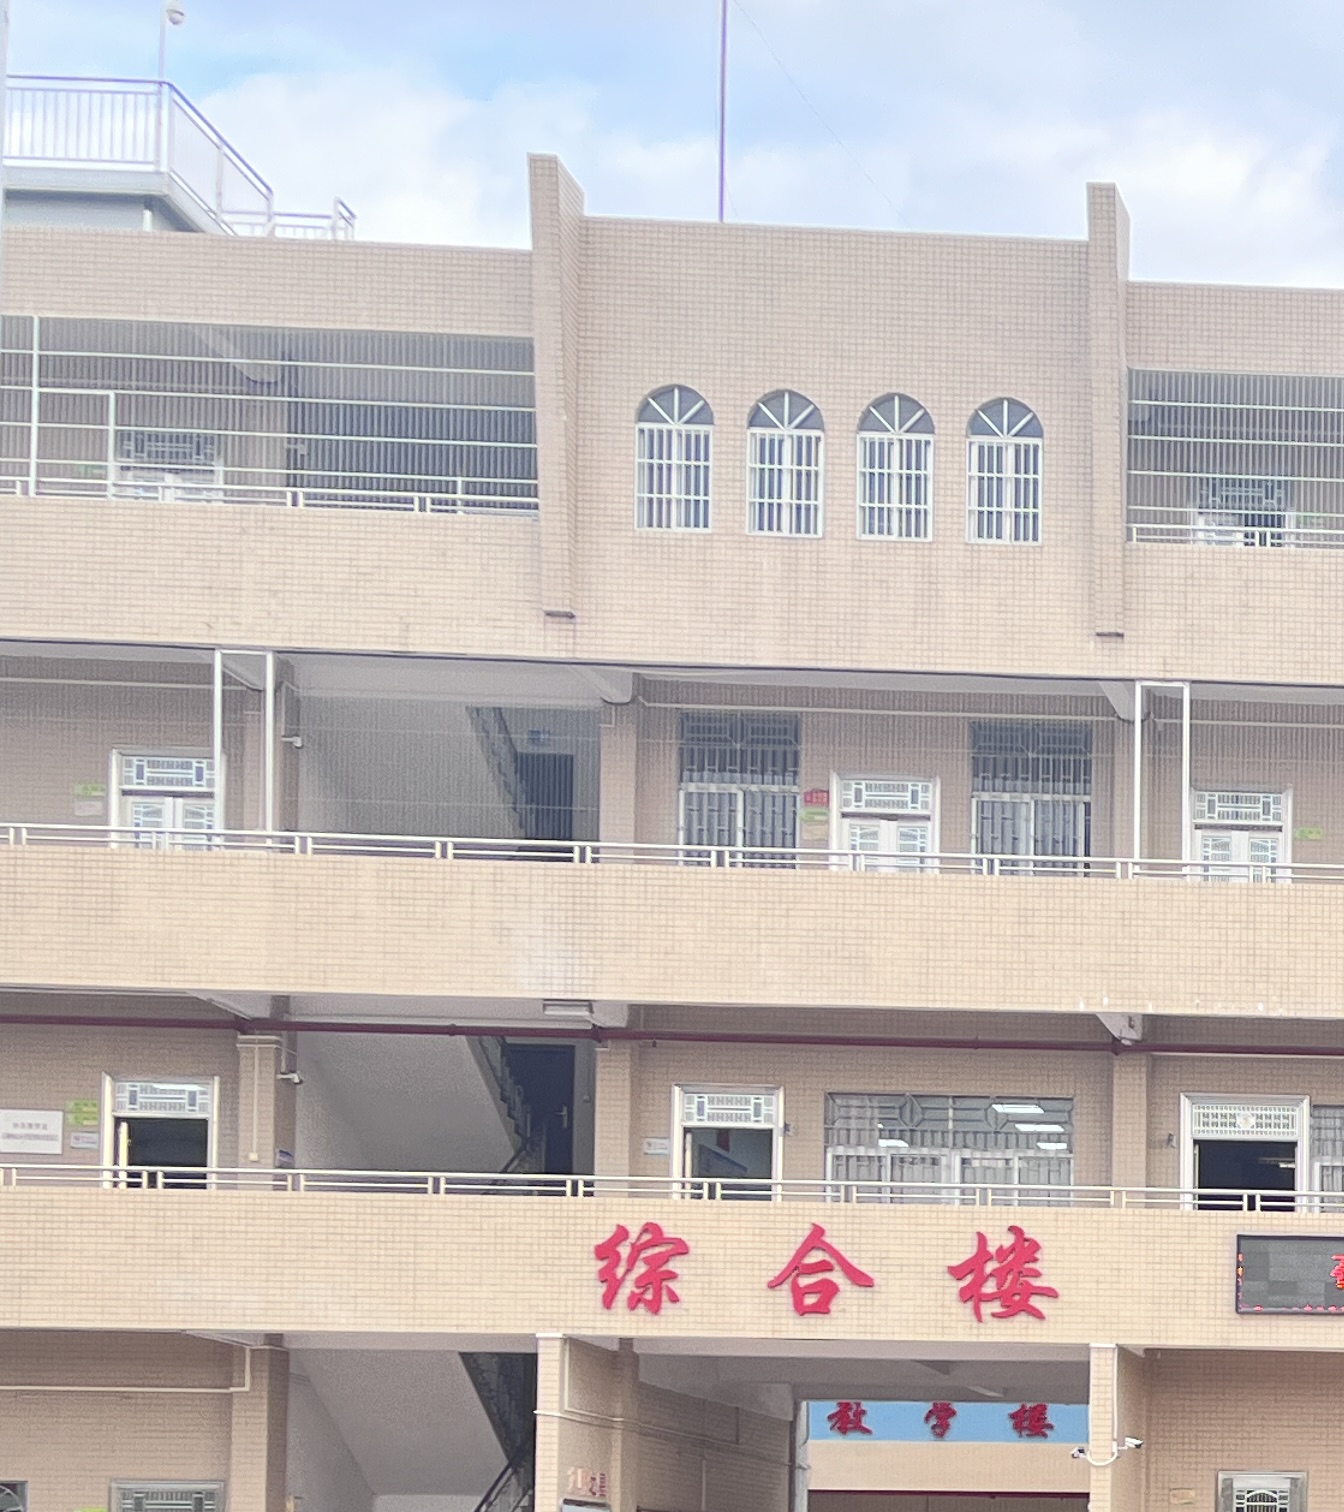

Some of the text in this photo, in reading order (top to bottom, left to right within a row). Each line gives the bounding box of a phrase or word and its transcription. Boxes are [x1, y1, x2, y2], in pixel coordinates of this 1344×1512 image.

[594, 1221, 1059, 1322] 综合楼
[827, 1401, 1056, 1440] 教学楼
